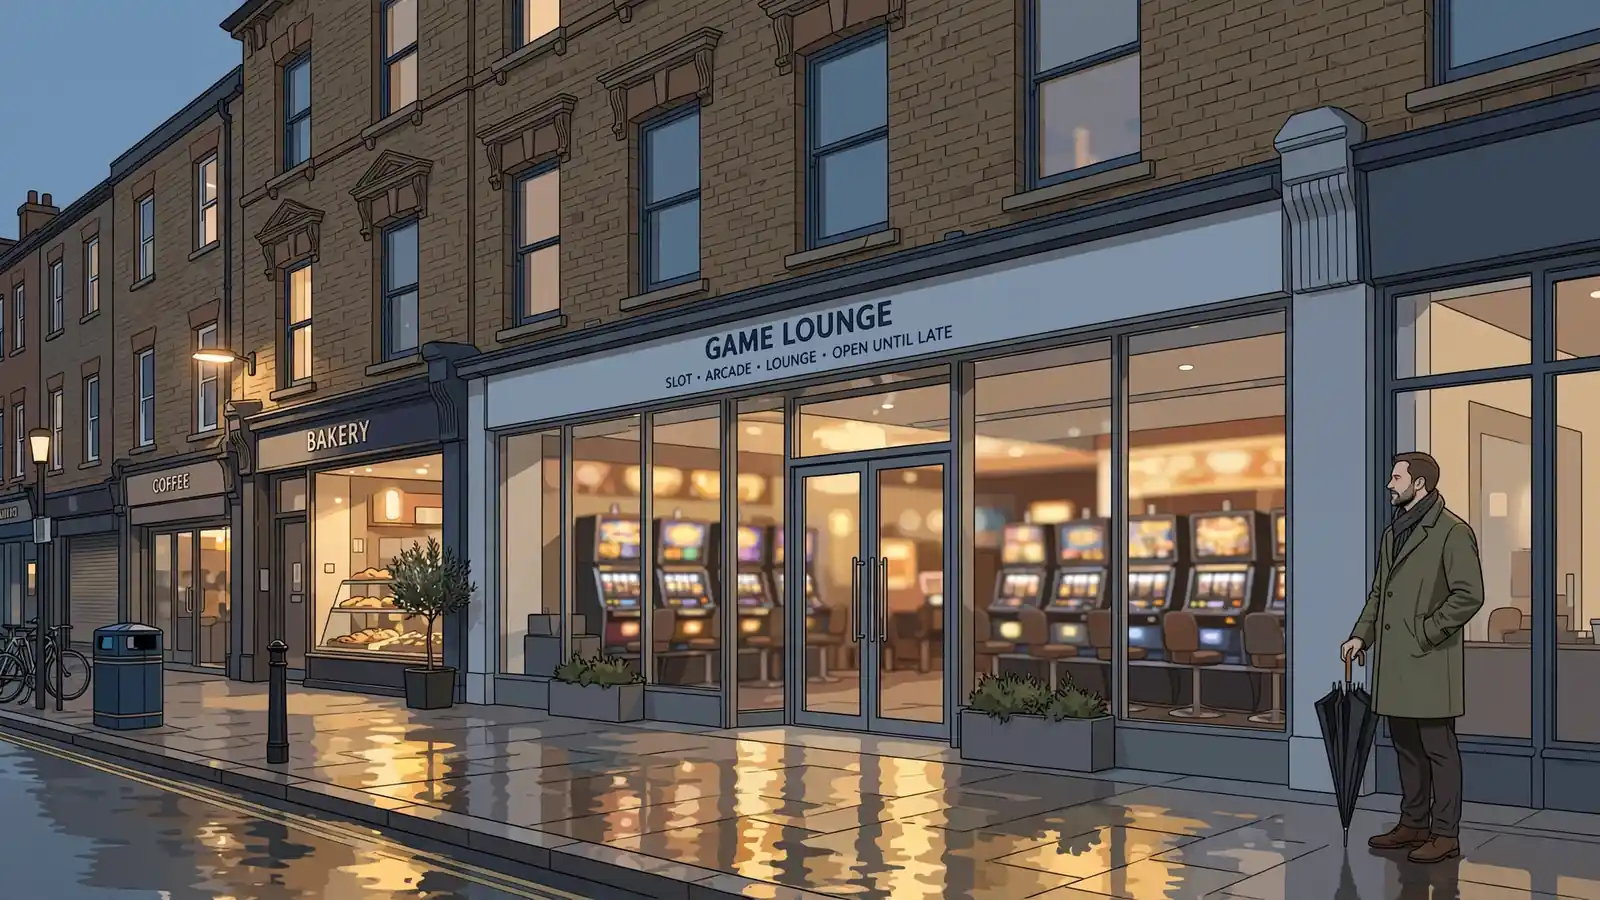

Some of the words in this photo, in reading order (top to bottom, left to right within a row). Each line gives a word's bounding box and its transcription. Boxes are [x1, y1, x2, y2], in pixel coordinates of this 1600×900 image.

[705, 325, 774, 360] GAME
[782, 300, 893, 346] LOUNGE
[665, 373, 693, 389] SLOT
[705, 362, 752, 382] ARCADE
[766, 350, 817, 371] LOUNGE
[832, 341, 868, 359] OPEN
[873, 333, 913, 352] UNTIL
[918, 325, 953, 344] LATE
[307, 419, 370, 452] BAKERY
[152, 473, 189, 493] COFFEE
